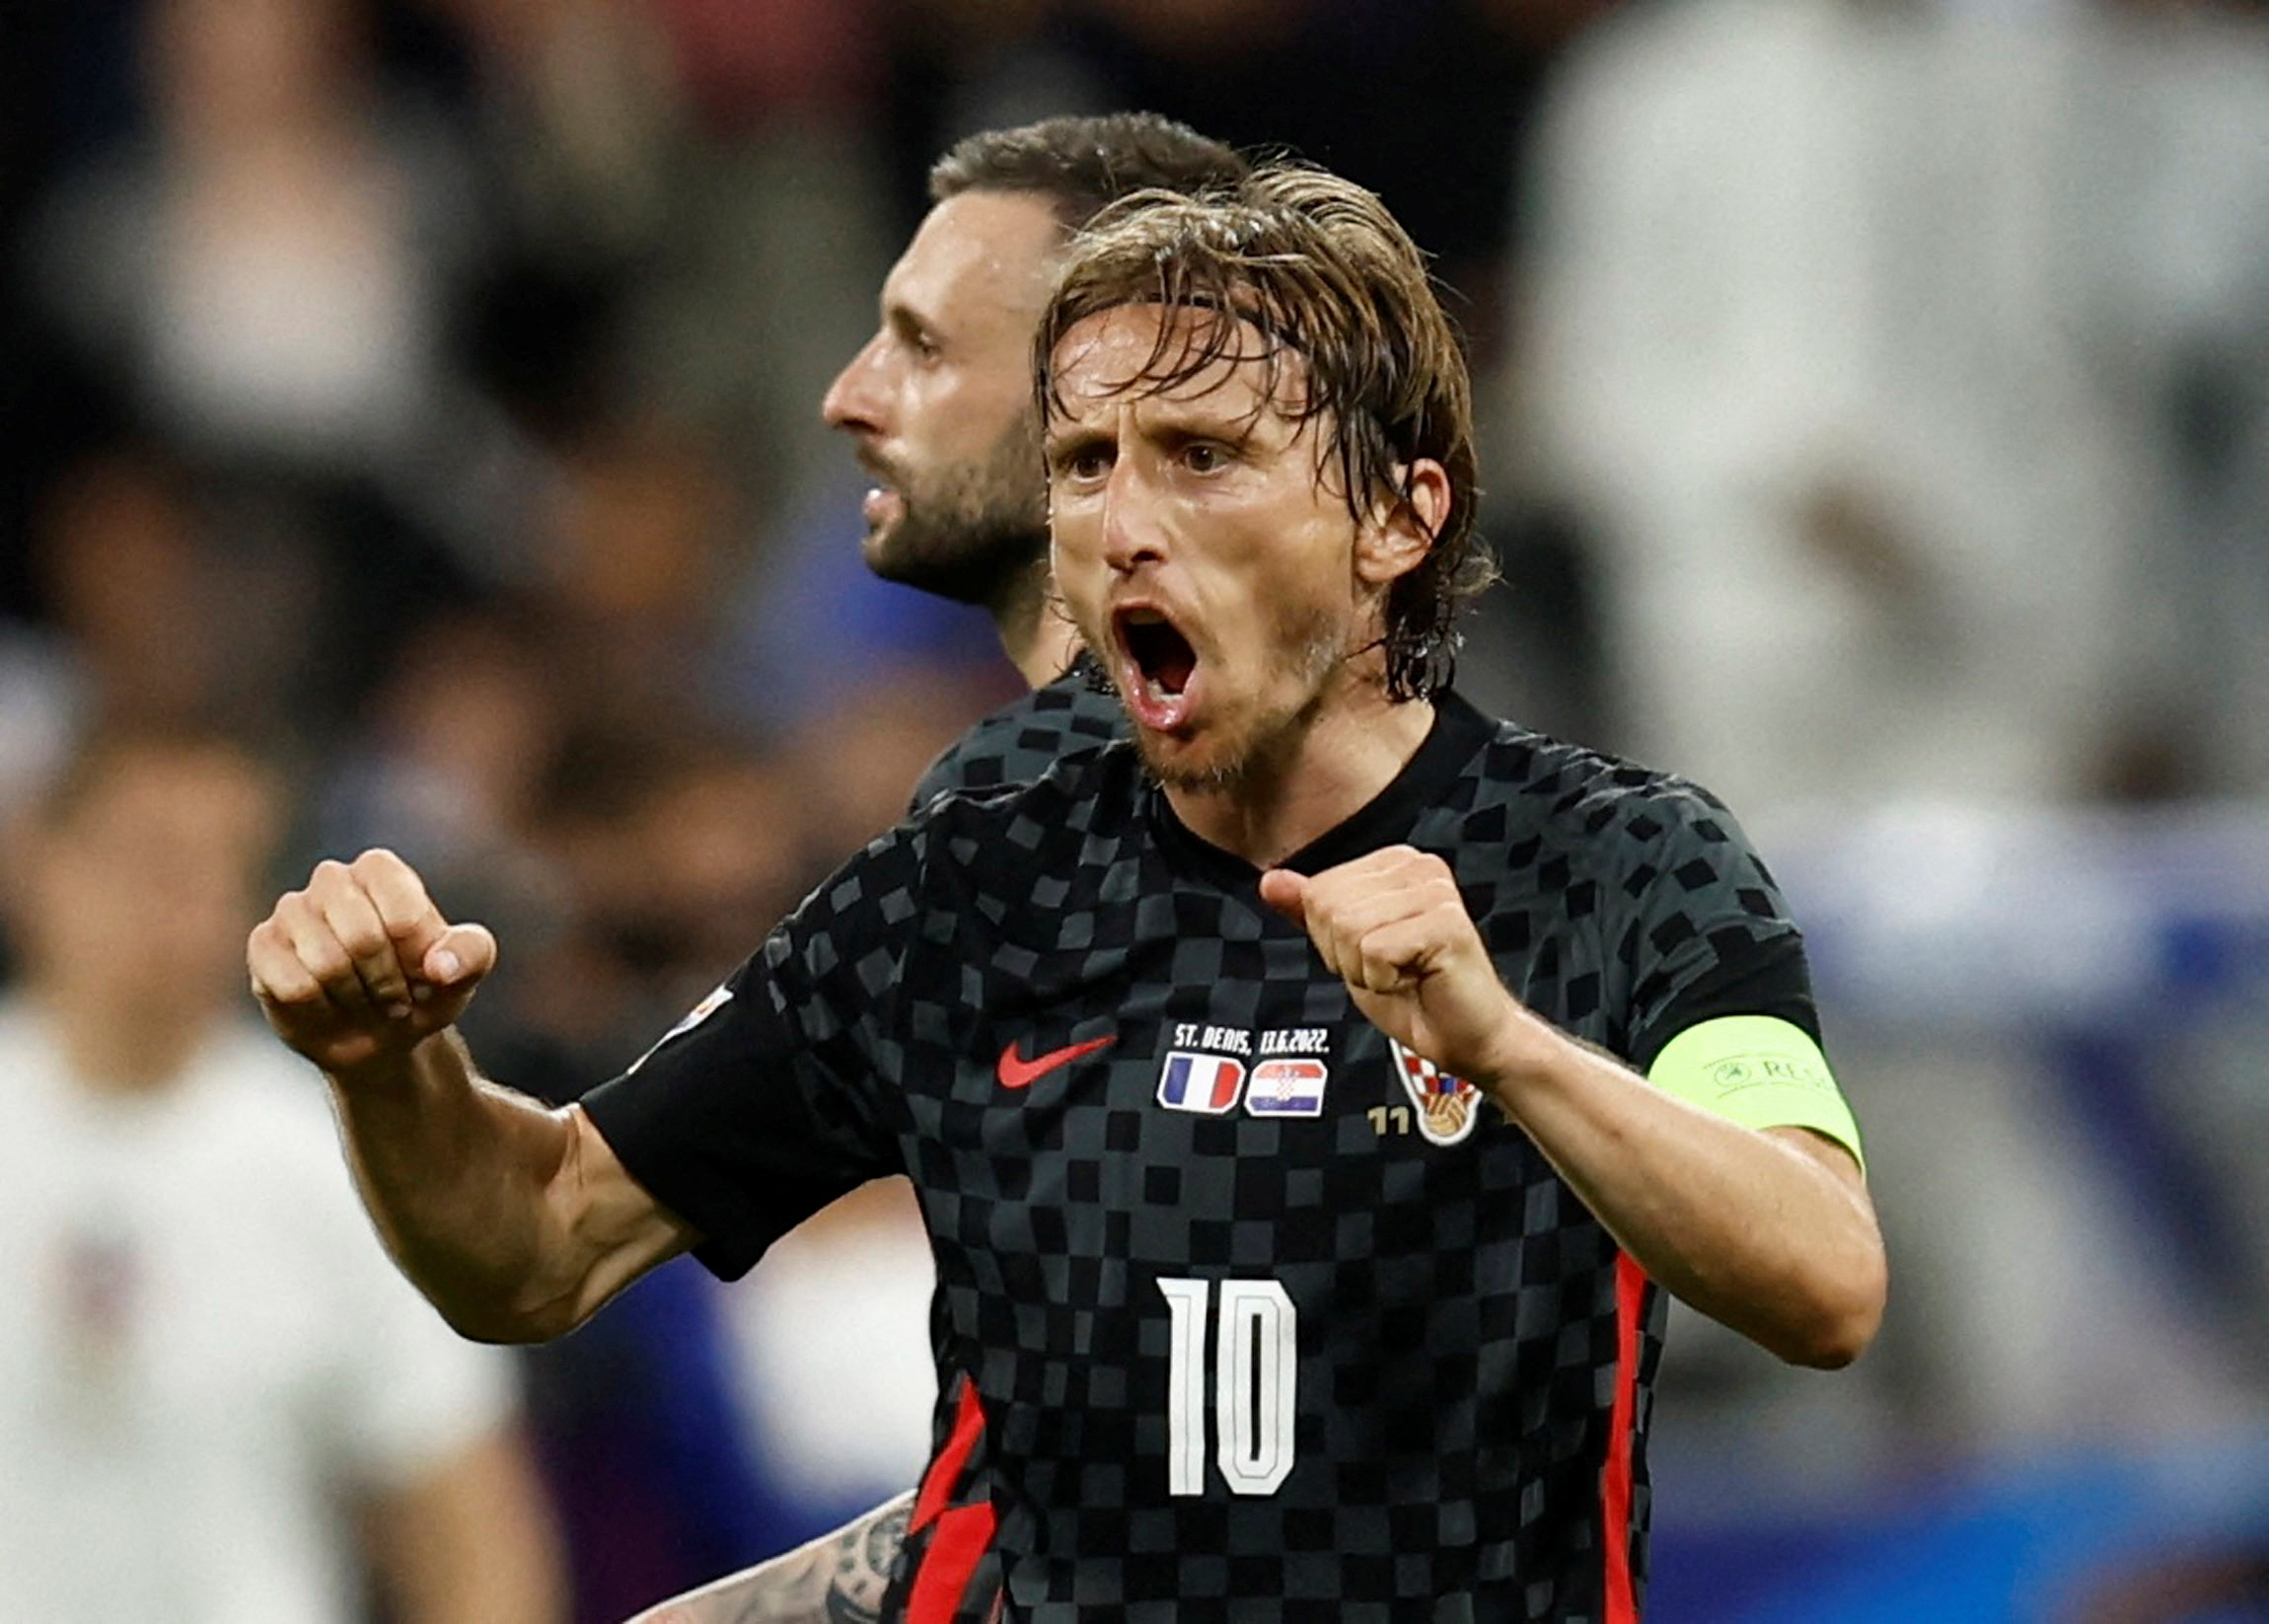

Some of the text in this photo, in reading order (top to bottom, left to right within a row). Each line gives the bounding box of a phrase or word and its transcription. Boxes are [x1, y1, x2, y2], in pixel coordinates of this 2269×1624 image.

[1174, 1023, 1198, 1047] ST.
[1202, 1026, 1252, 1057] DENIS,
[1367, 1106, 1410, 1136] 11
[1155, 1277, 1297, 1497] 10
